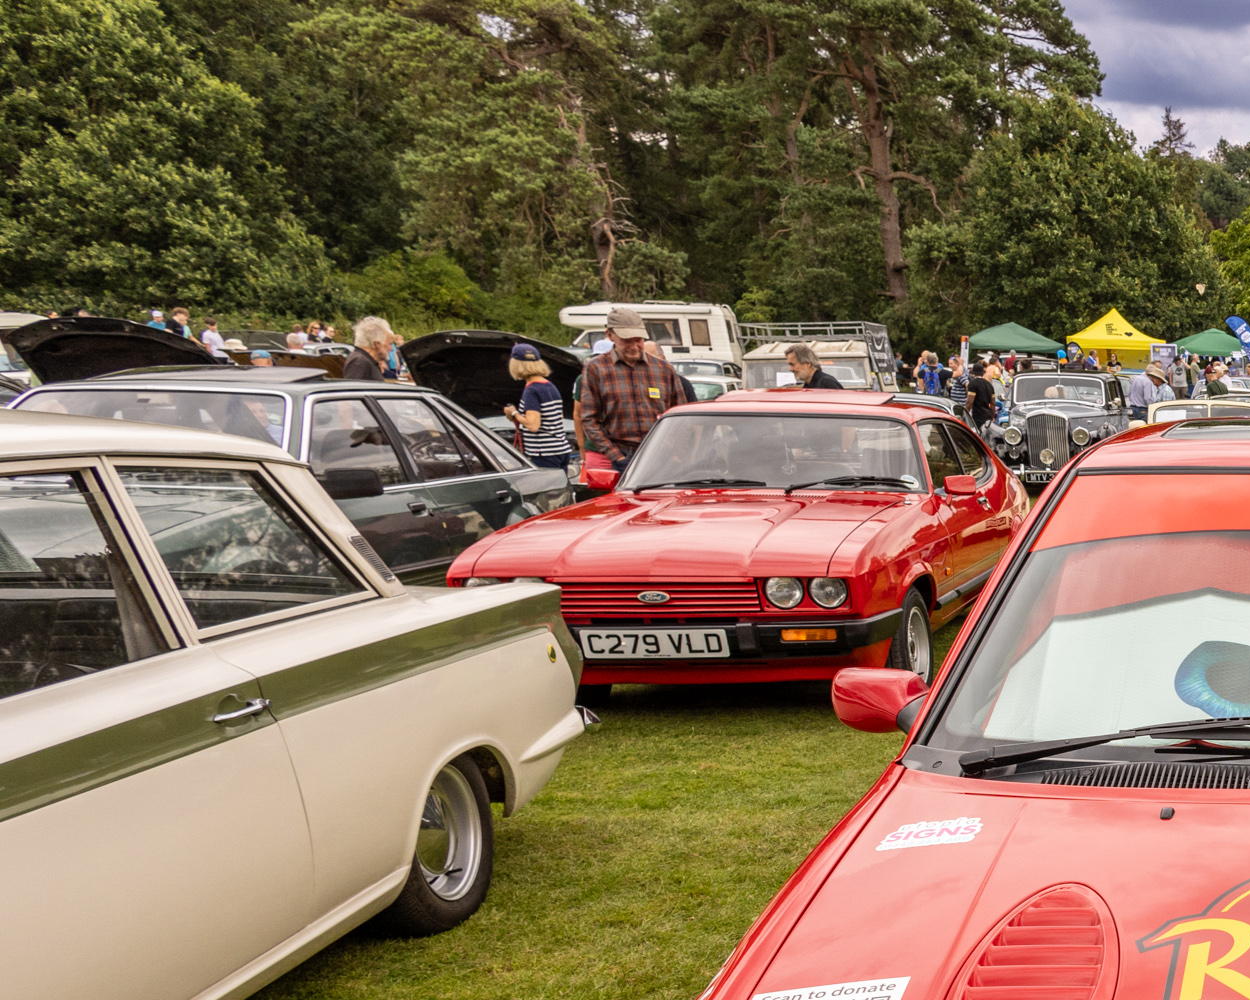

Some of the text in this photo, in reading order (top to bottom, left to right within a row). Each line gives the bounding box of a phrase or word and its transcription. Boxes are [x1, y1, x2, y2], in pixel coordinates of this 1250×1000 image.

[587, 633, 723, 654] C279 VLD
[885, 825, 979, 843] SIGNS
[808, 990, 827, 1000] to
[831, 982, 897, 997] donate
